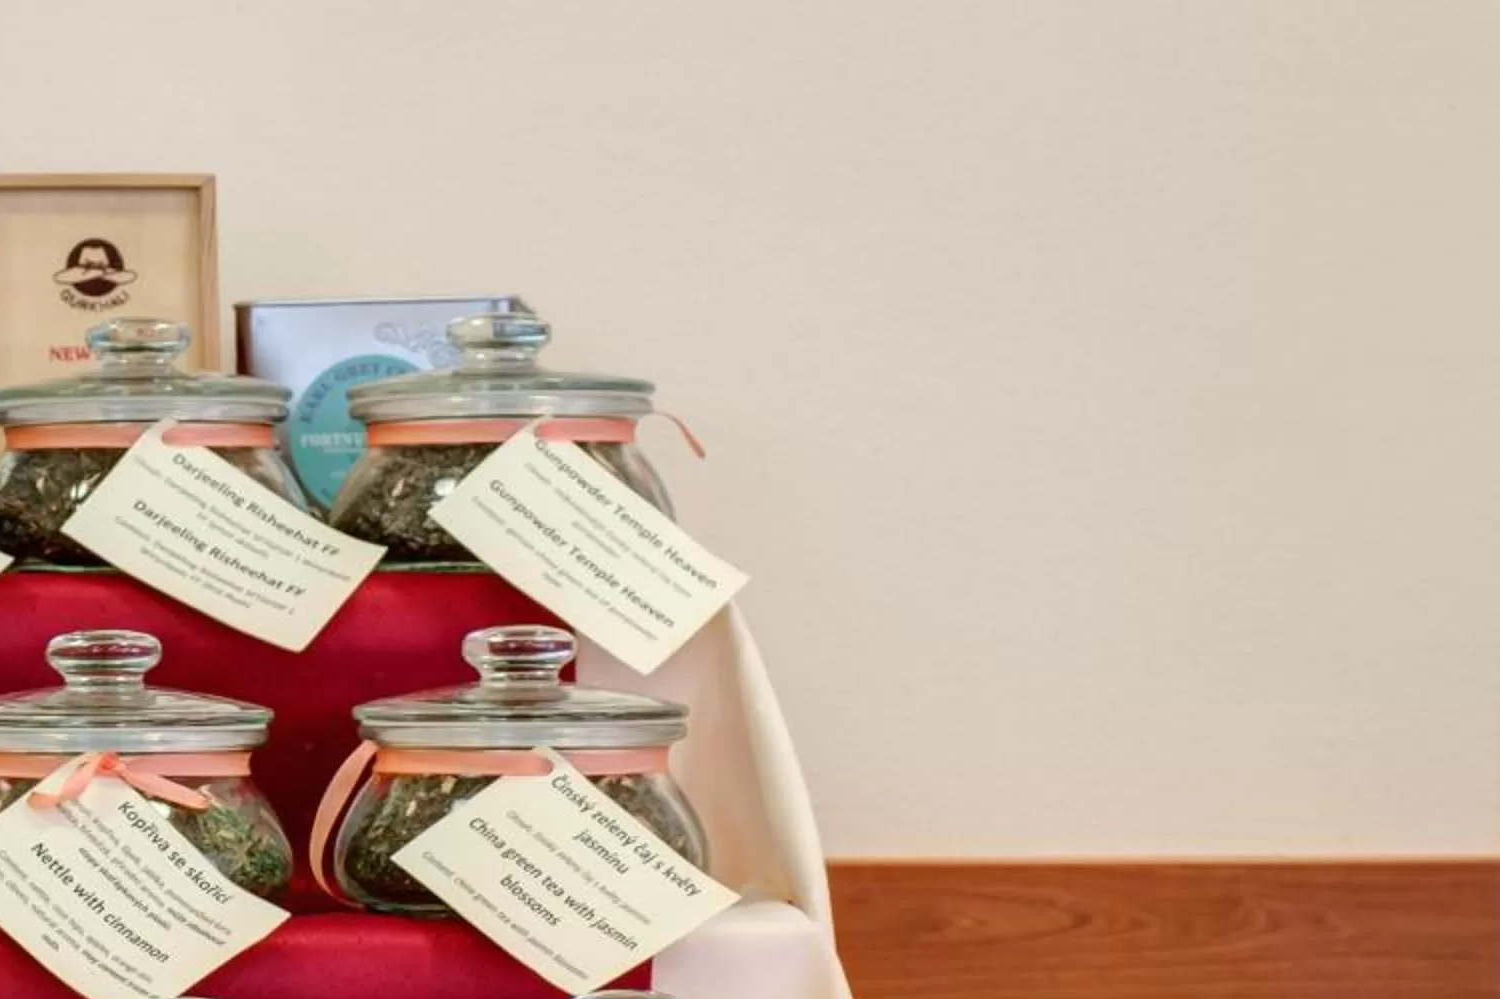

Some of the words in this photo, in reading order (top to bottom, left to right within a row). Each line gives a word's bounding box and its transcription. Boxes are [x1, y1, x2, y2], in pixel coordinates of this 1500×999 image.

[171, 452, 245, 508] Darjeeling
[132, 499, 208, 552] Darjeeling
[488, 478, 568, 547] Gunpowder
[568, 544, 620, 588] Temple
[619, 585, 675, 628] Heaven
[612, 503, 663, 549] Temple
[663, 545, 717, 589] Heaven
[117, 800, 170, 852] Kopřiva
[166, 850, 187, 870] se
[590, 810, 637, 846] zelený
[651, 859, 665, 871] s
[661, 865, 701, 897] květy
[30, 841, 74, 885] Nettle
[72, 883, 105, 915] with
[102, 912, 169, 963] cinnamon
[468, 816, 506, 849] China
[499, 847, 543, 879] green
[540, 874, 565, 897] tea
[562, 894, 595, 921] with
[589, 916, 638, 951] jasmin
[499, 873, 560, 926] blossoms
